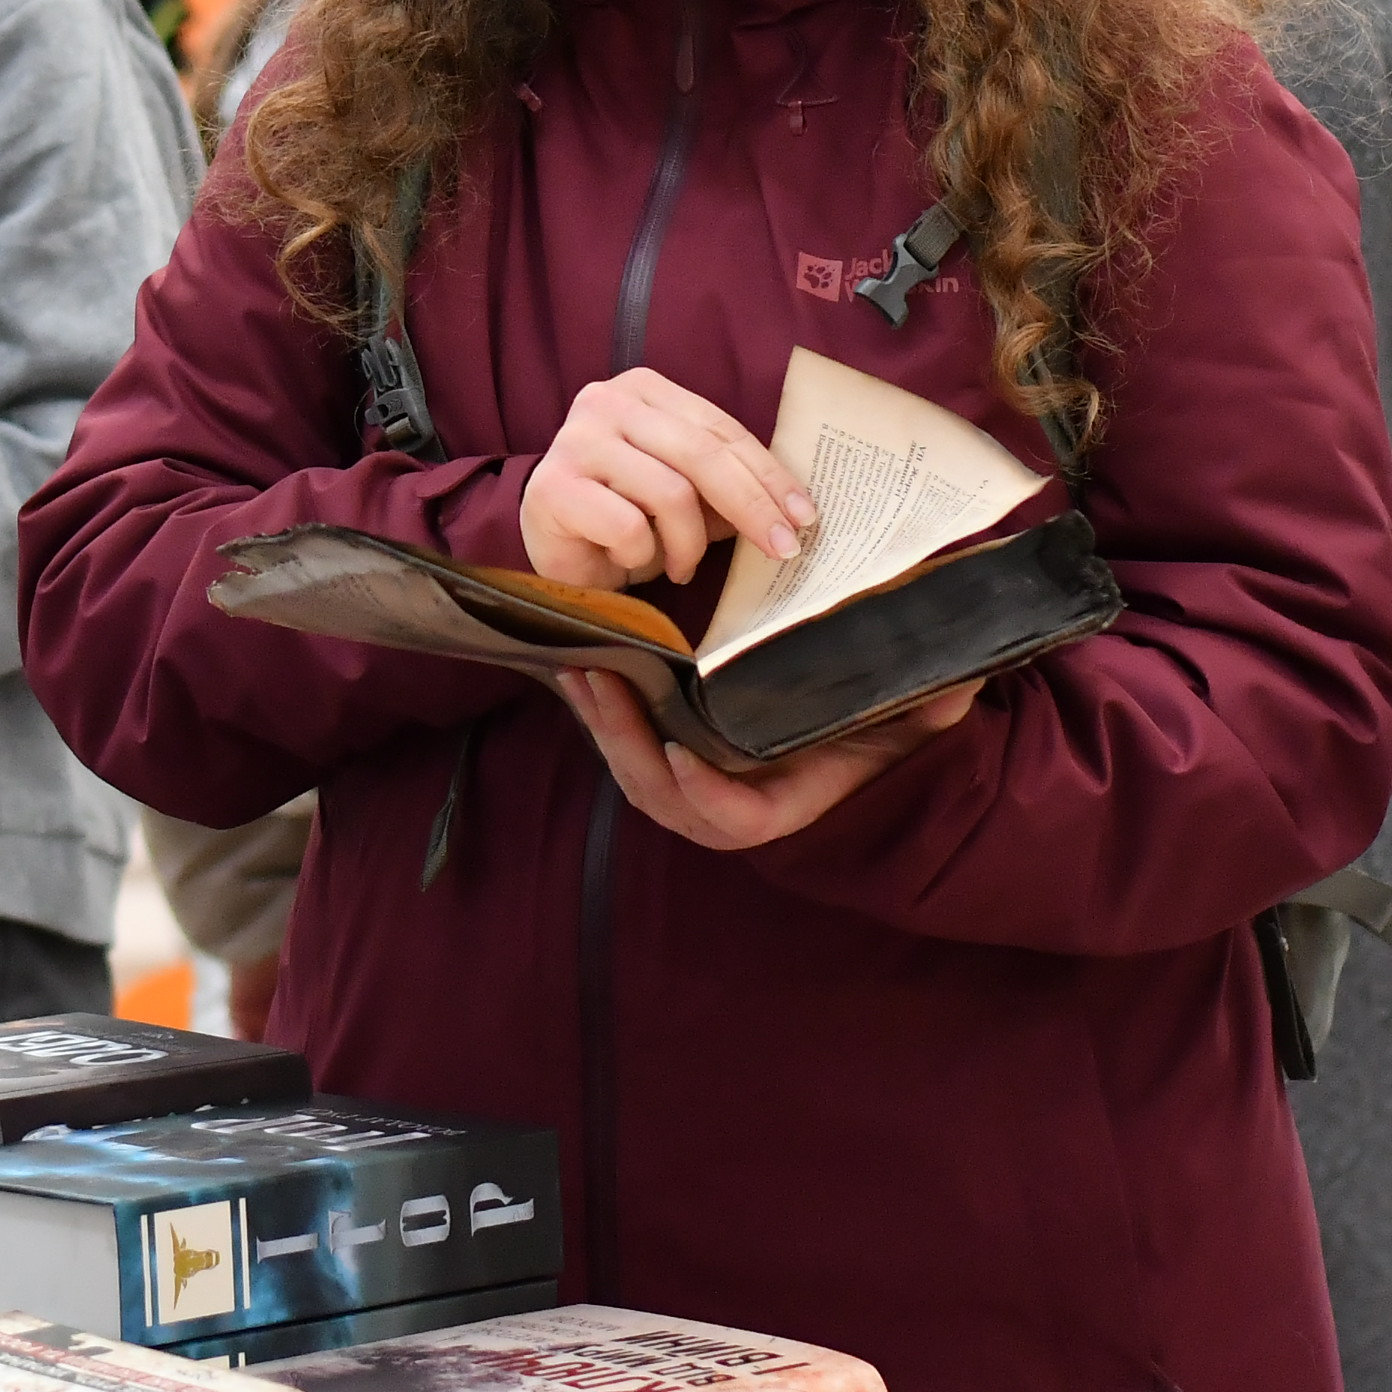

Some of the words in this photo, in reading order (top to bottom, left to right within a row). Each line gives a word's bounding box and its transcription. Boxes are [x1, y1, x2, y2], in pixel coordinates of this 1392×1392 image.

[891, 465, 919, 519] Жорстока
[548, 1343, 674, 1368] МИРУ
[608, 1330, 784, 1368] ВІЙНИ
[651, 1362, 737, 1387] ВІД
